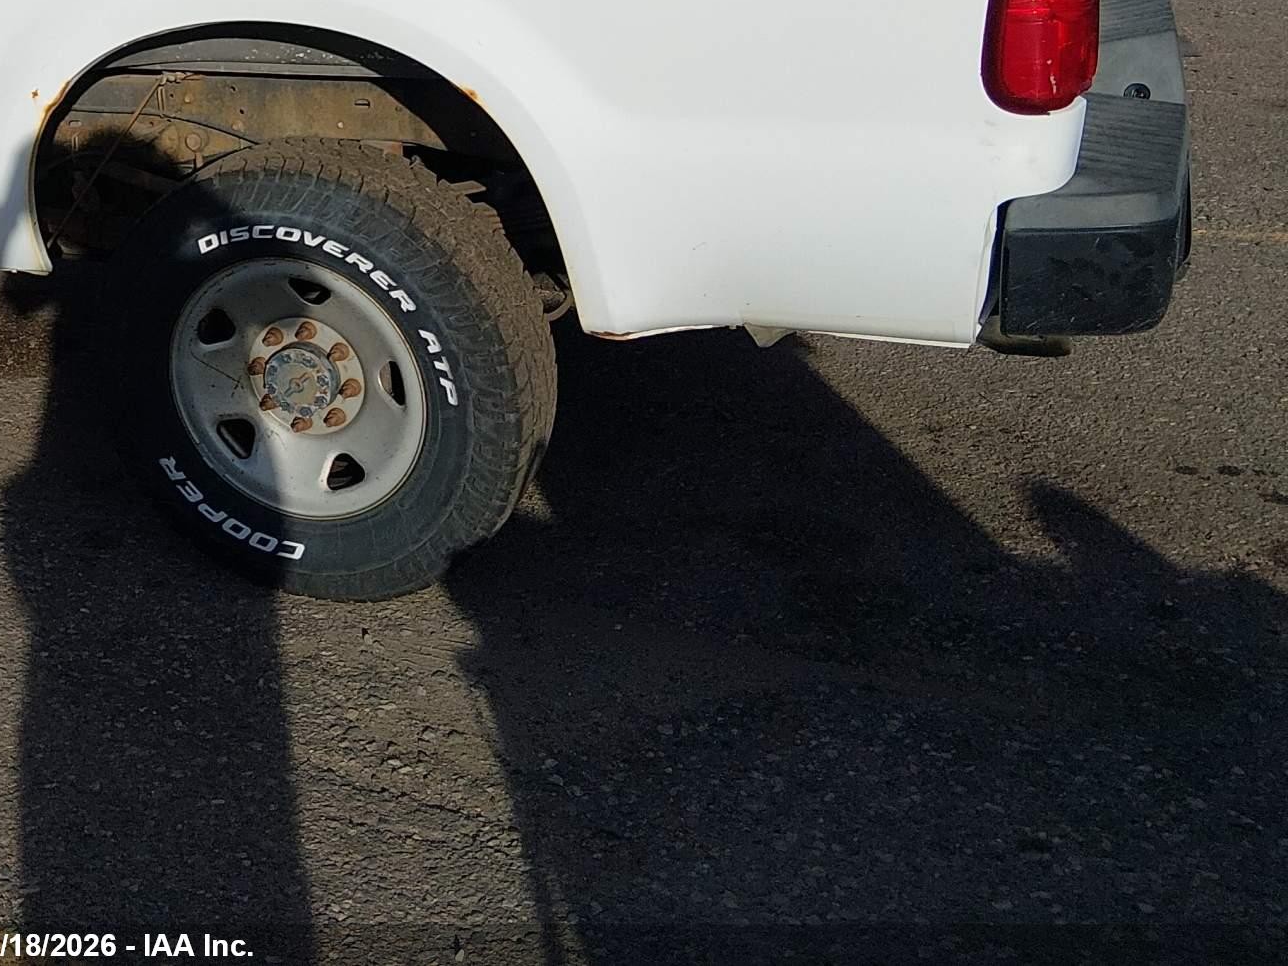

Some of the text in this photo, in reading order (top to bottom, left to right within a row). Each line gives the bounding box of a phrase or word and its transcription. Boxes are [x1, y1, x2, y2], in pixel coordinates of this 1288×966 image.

[197, 225, 459, 406] DISCOVERER ATP
[159, 456, 306, 560] COOPER
